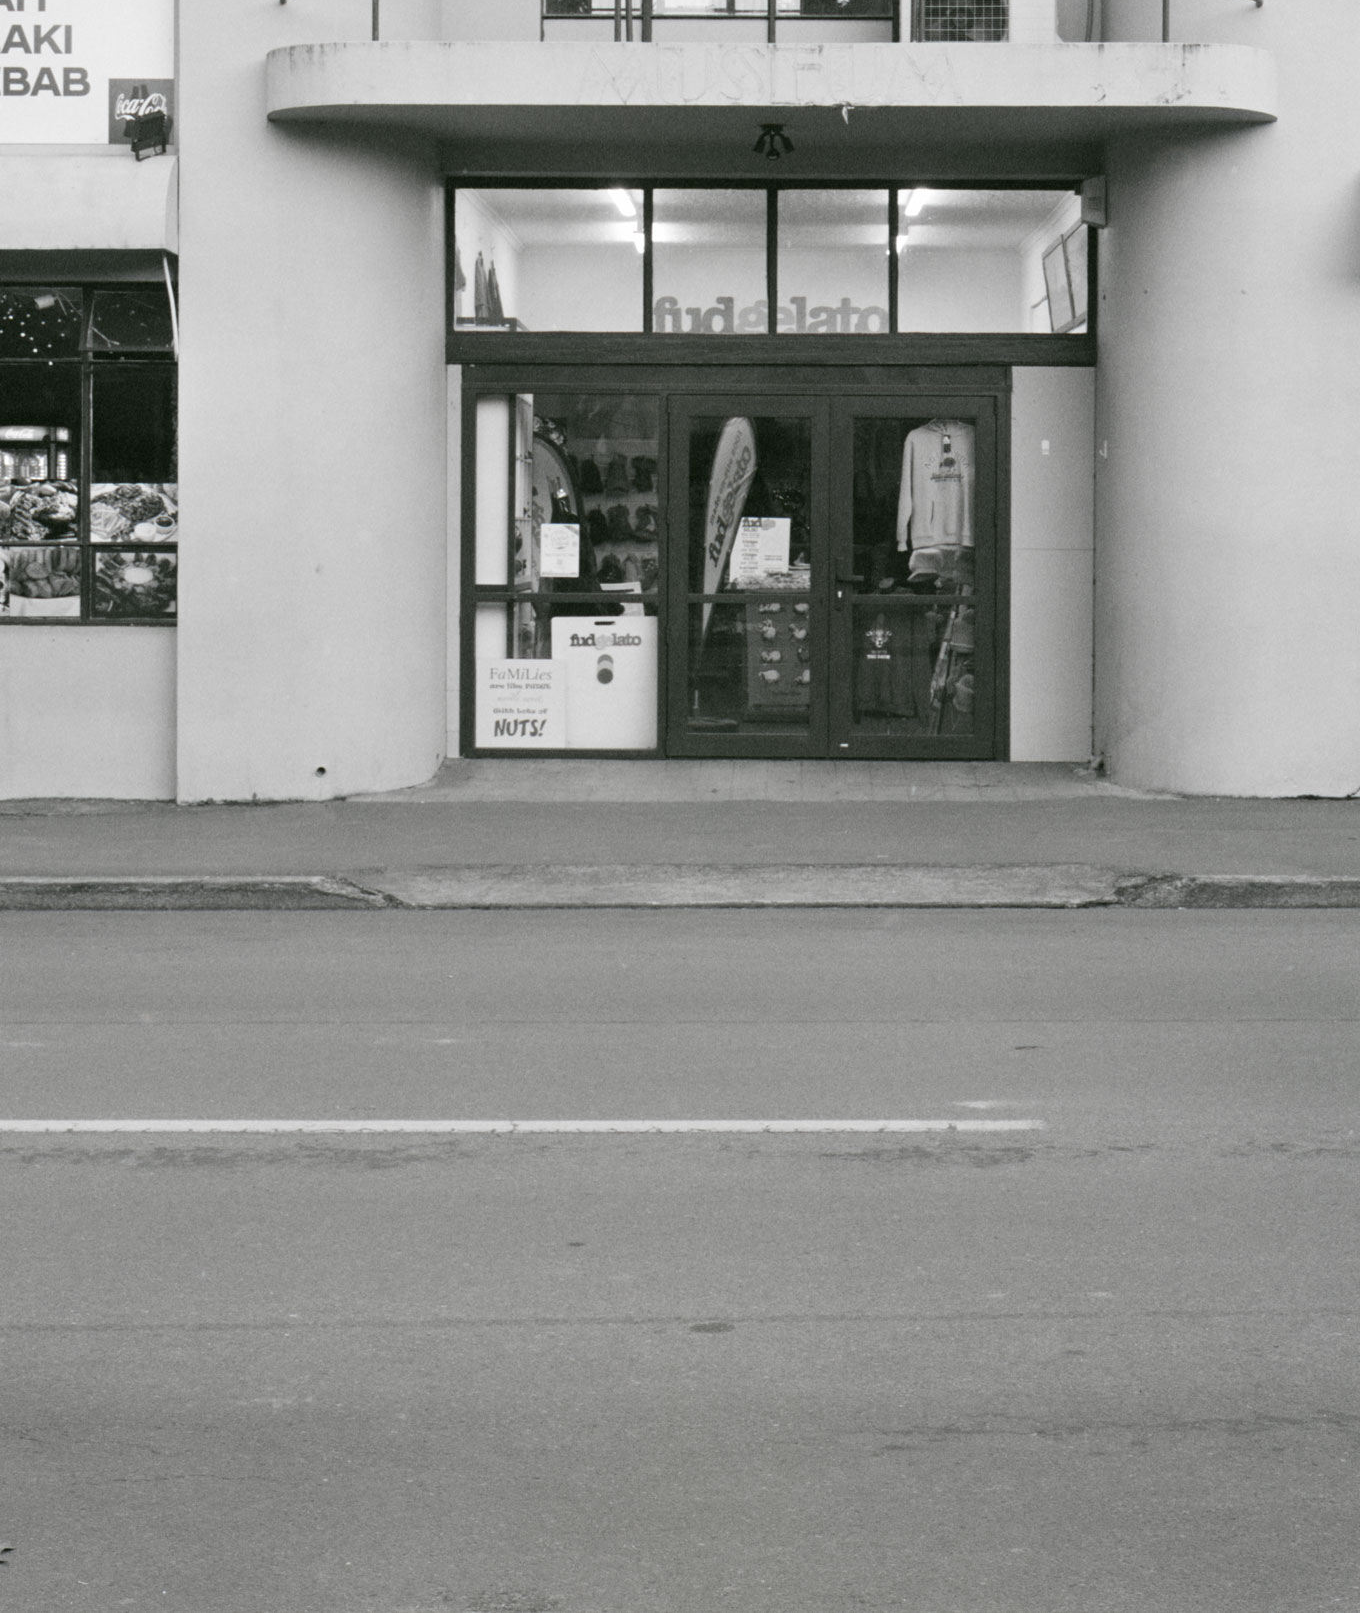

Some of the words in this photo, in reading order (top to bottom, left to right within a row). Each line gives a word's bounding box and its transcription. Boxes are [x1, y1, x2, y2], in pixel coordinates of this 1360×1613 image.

[115, 92, 168, 121] Coca-C
[652, 295, 890, 333] fudgelato
[570, 633, 642, 650] fudgelato
[493, 718, 548, 738] NUTS!
